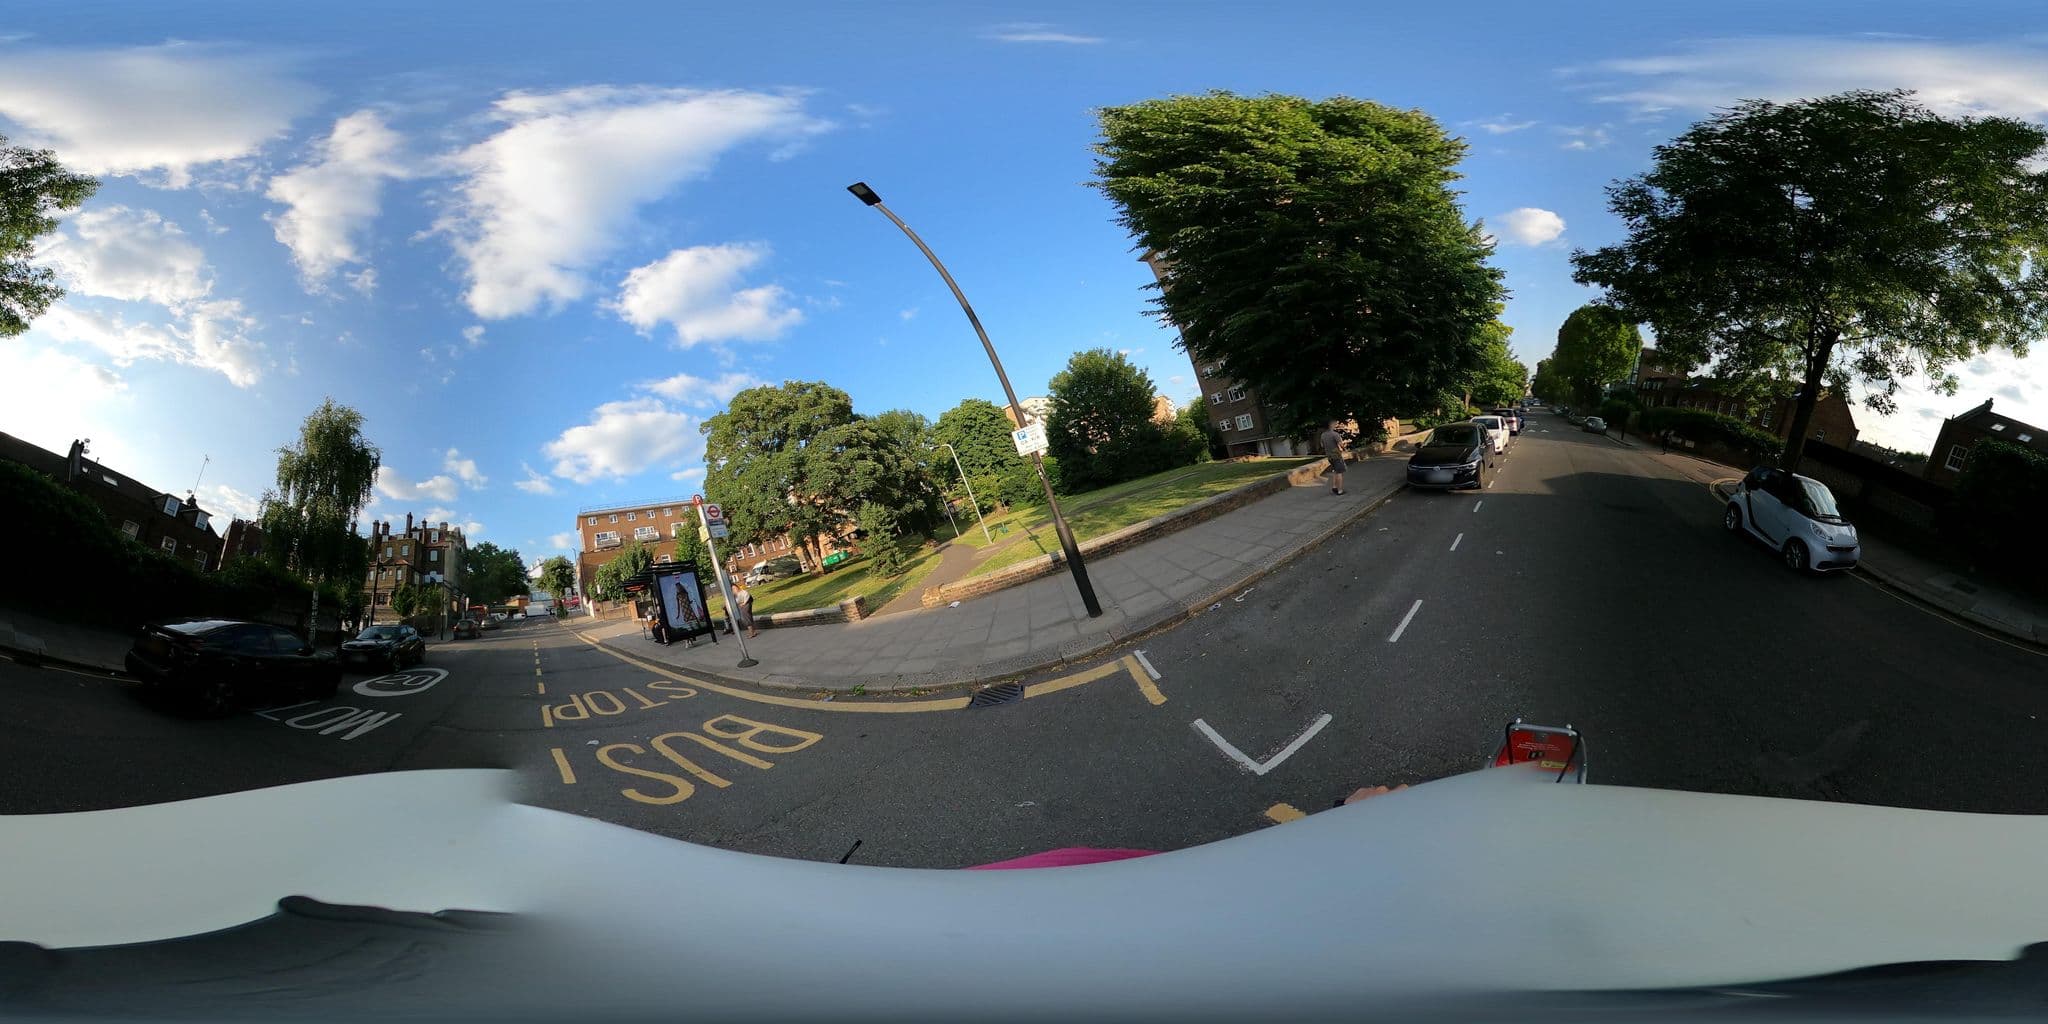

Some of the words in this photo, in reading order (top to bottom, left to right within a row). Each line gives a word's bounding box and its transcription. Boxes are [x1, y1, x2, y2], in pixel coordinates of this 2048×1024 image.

[376, 674, 435, 686] 20
[552, 680, 698, 720] STOP
[254, 700, 403, 740] LOW
[596, 714, 824, 805] BUS
